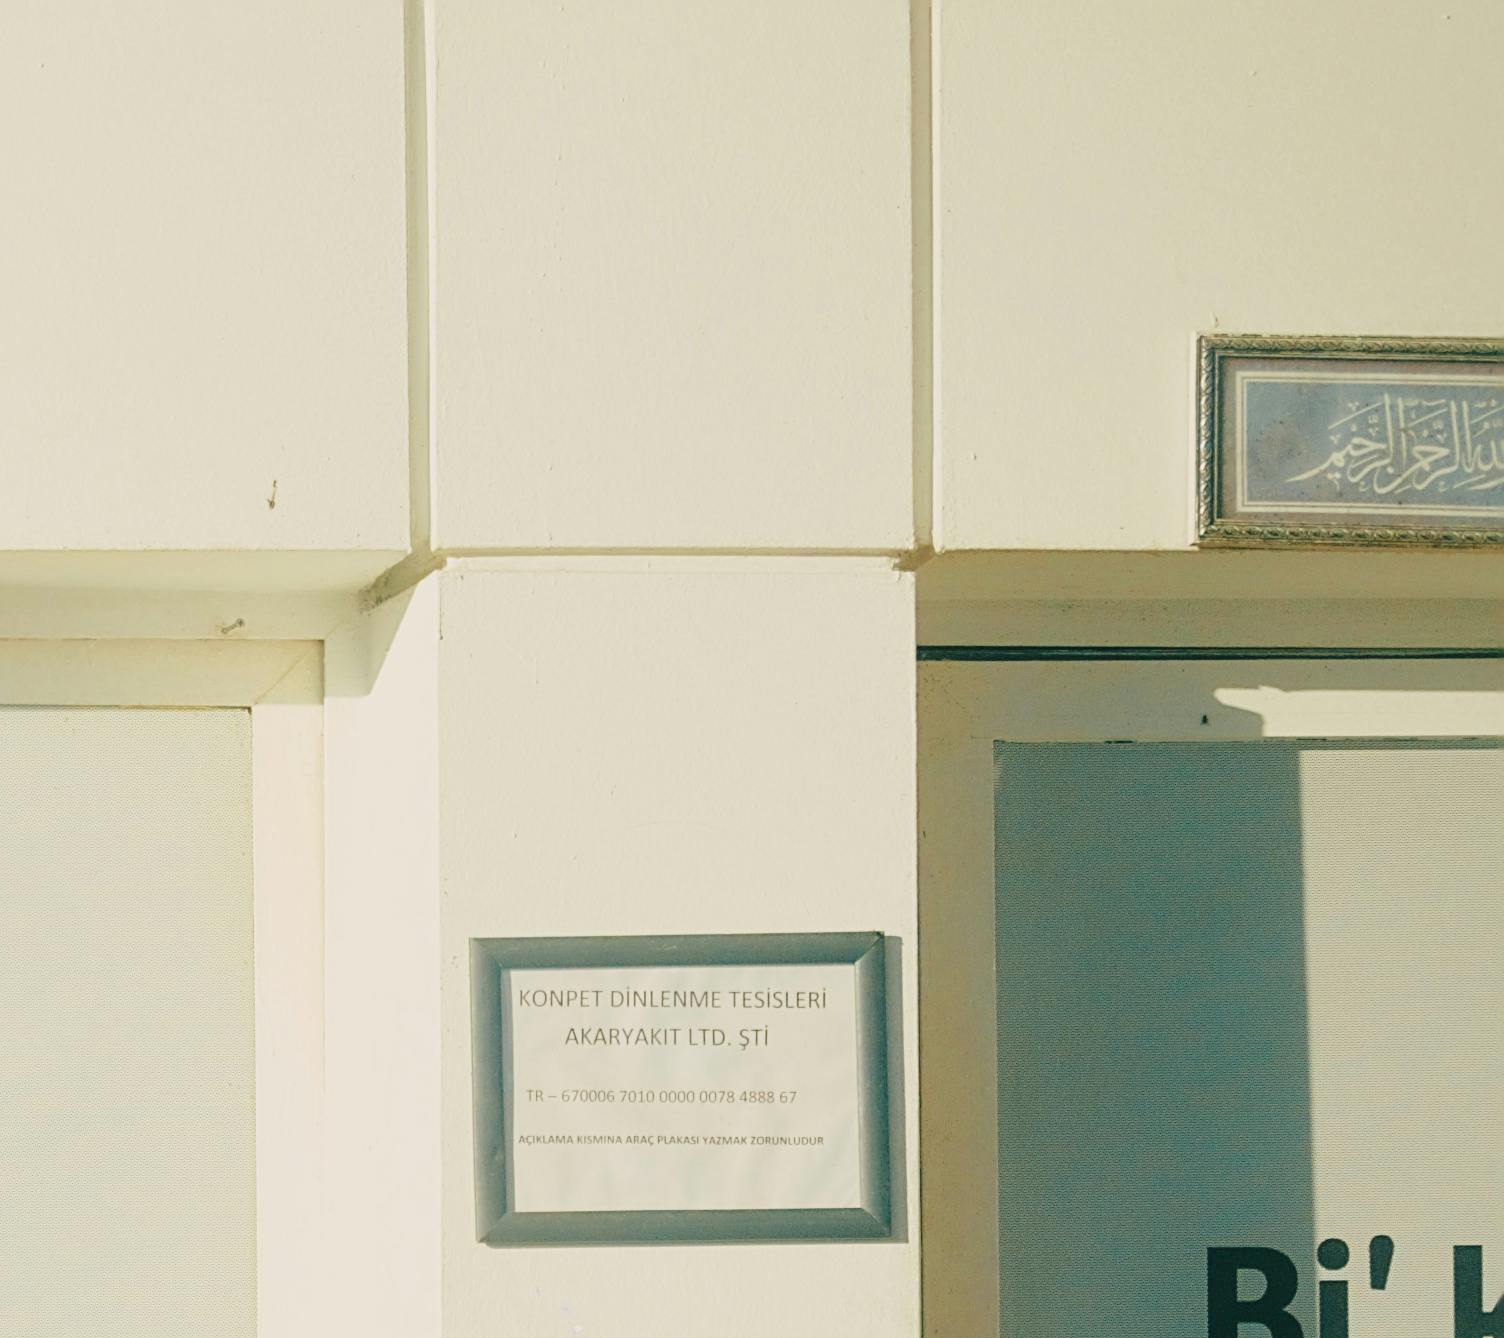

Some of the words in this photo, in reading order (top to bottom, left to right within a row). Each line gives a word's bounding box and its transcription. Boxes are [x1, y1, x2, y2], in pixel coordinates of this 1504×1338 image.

[518, 988, 602, 1009] KONPET
[610, 986, 722, 1009] DİNLENME
[729, 986, 828, 1010] TESİSLERİ
[564, 1027, 682, 1047] AKARYAKIT
[688, 1027, 733, 1048] LTD.
[738, 1025, 769, 1051] ŞTİ
[526, 1089, 544, 1103] TR
[561, 1089, 616, 1104] 670006
[619, 1089, 656, 1104] 7010
[659, 1089, 696, 1104] 0000
[698, 1089, 736, 1104] 0078
[778, 1089, 798, 1104] 67
[518, 1135, 574, 1148] AÇIKLAMA
[576, 1135, 623, 1146] KISMINA
[625, 1135, 656, 1148] ARAÇ
[657, 1135, 700, 1146] PLAKASI
[702, 1135, 748, 1146] YAZMAK
[750, 1135, 825, 1147] ZORUNLUDUR
